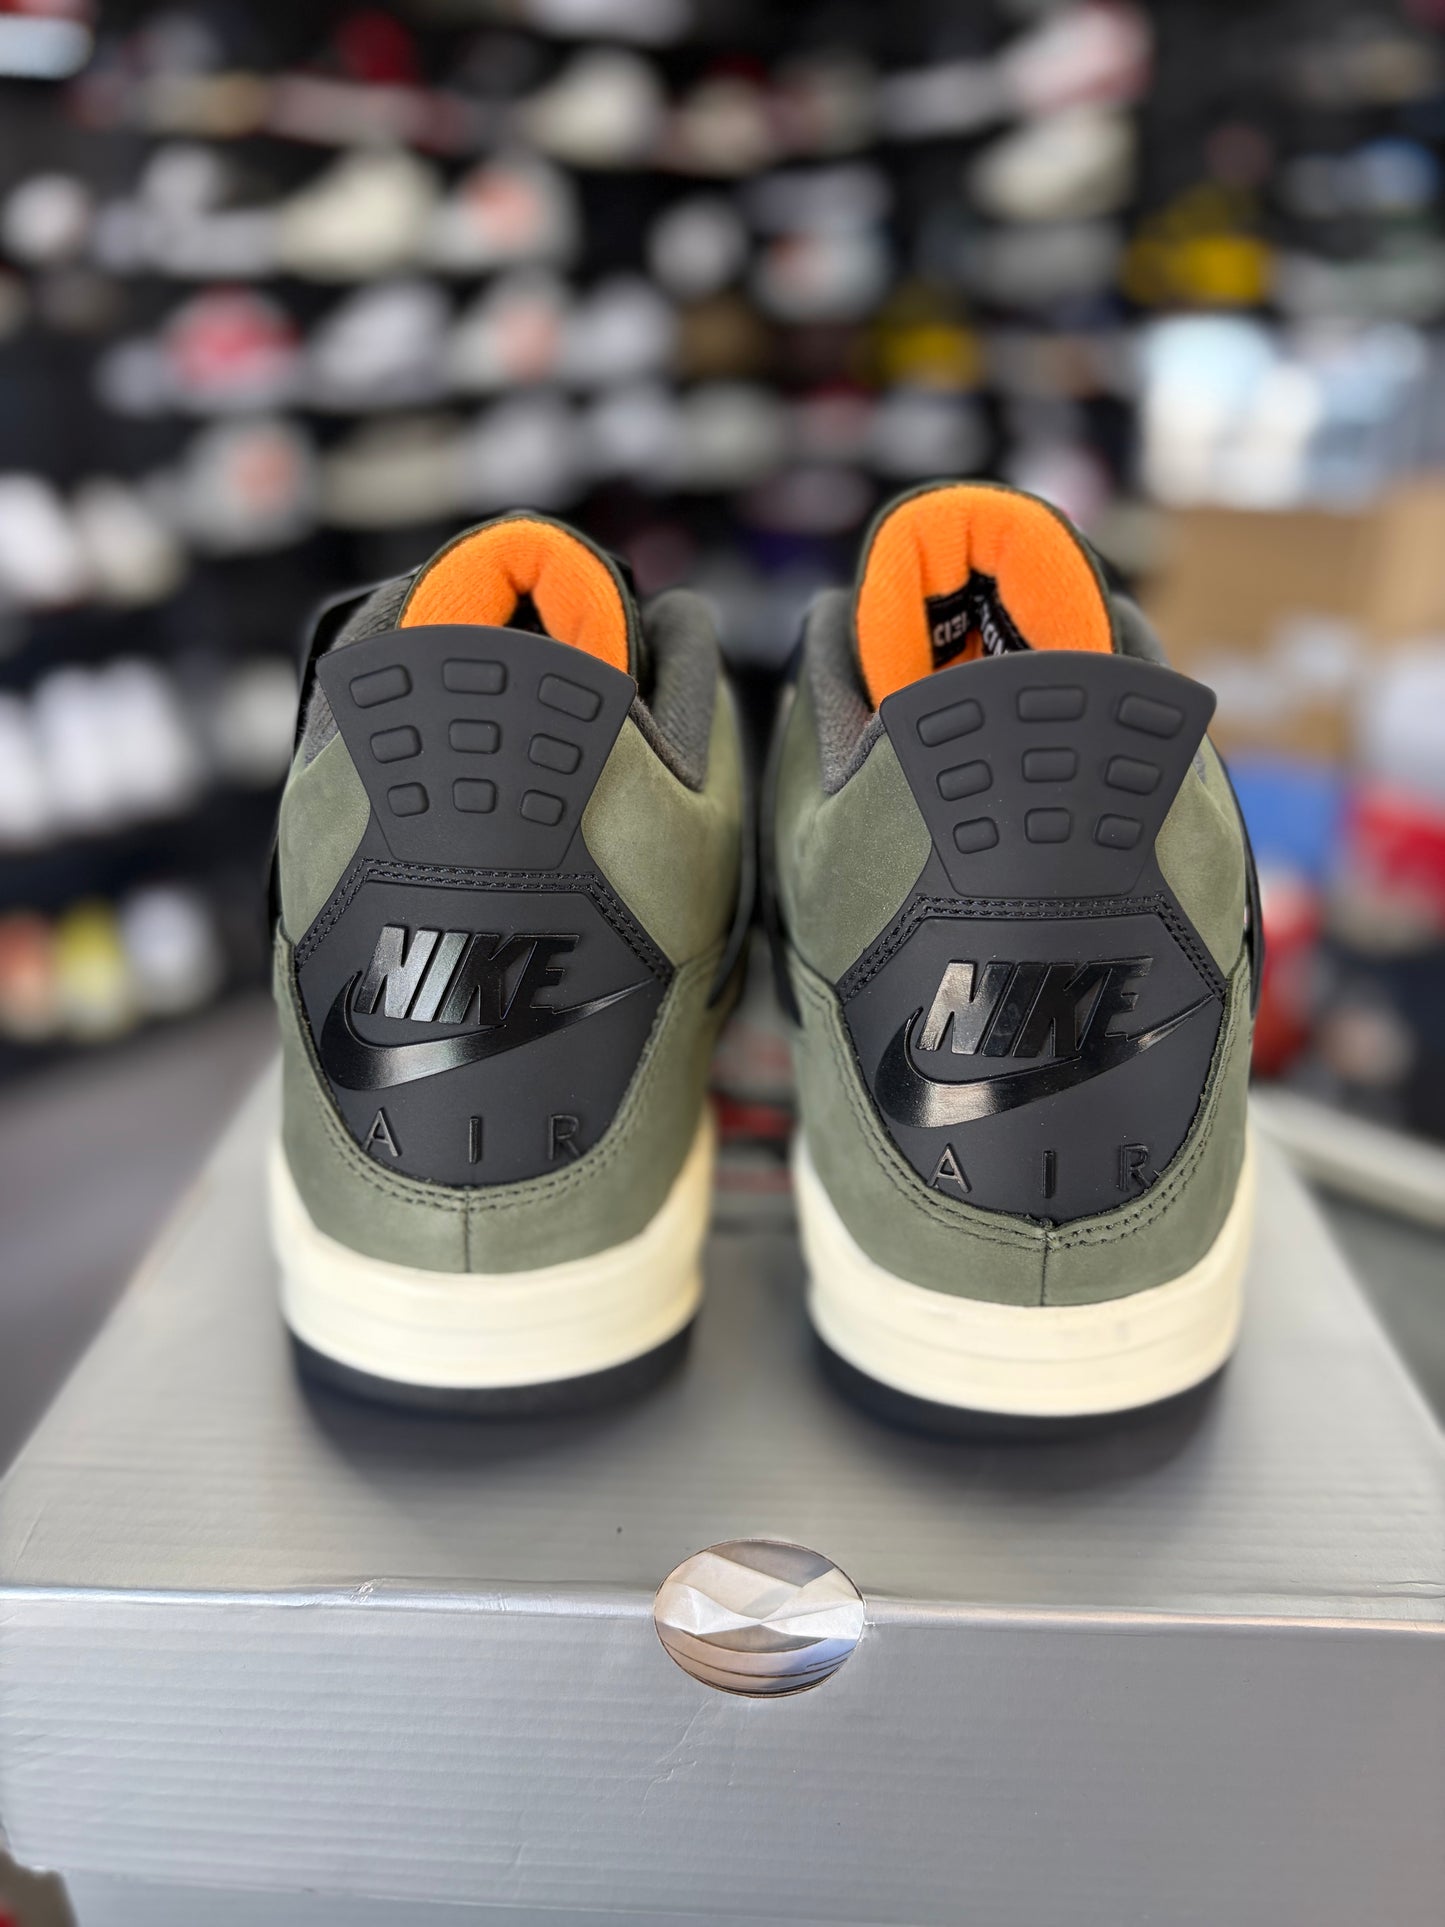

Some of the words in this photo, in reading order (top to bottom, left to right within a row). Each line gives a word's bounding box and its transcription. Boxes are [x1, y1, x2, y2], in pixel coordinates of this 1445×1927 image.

[354, 924, 580, 1025] NIKE
[916, 959, 1154, 1058] NIKE
[363, 1107, 581, 1164] AIR
[927, 1143, 1152, 1199] AIR
